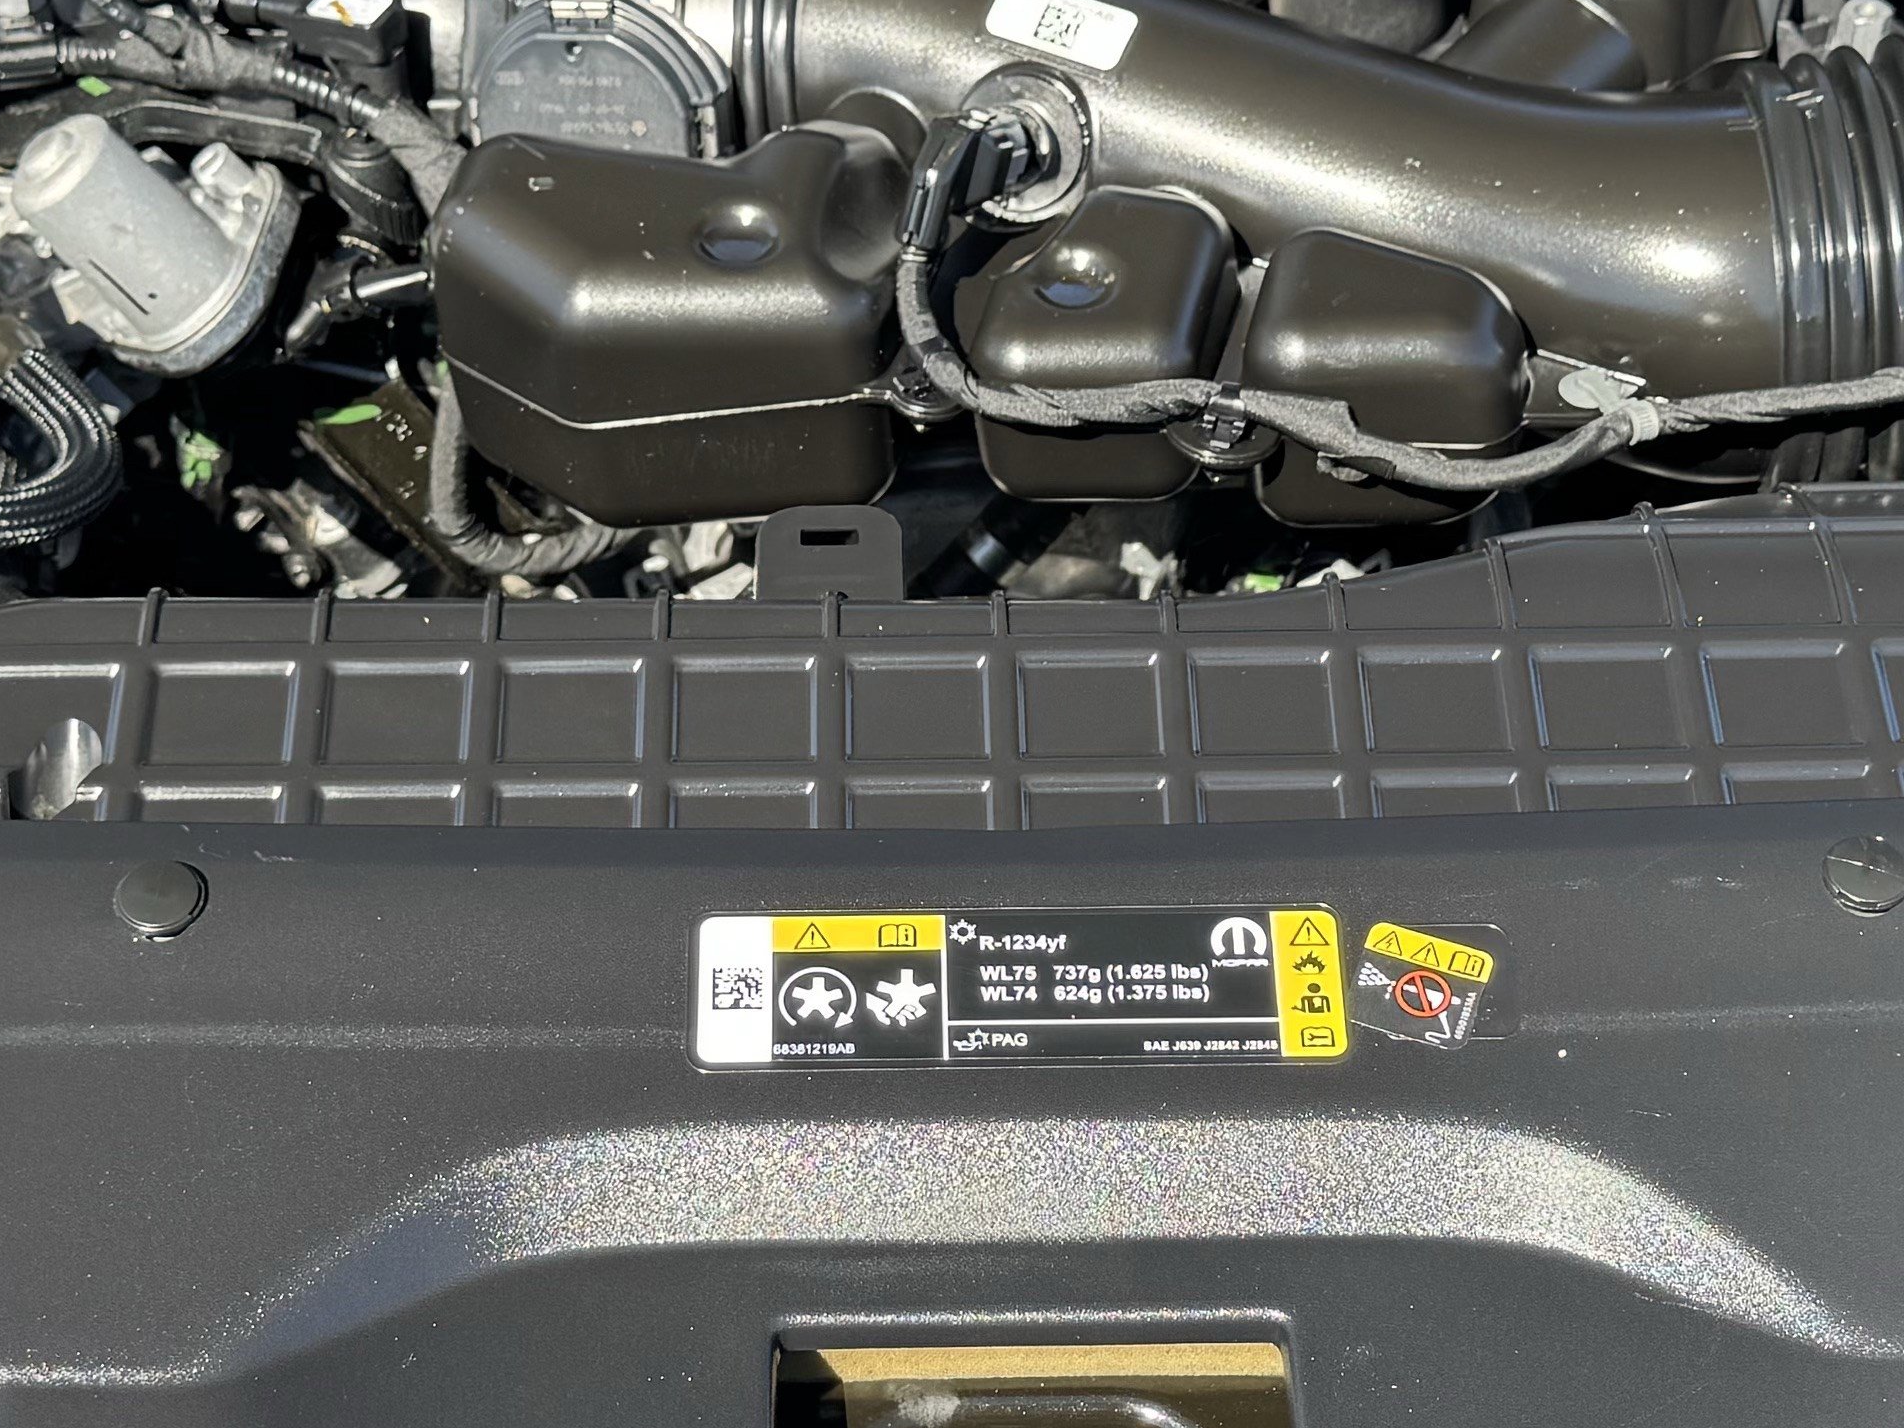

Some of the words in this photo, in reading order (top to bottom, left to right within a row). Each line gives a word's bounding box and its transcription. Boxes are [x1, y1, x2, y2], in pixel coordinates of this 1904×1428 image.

[979, 934, 1067, 954] R-1234yf
[979, 965, 1037, 982] WL75
[1053, 964, 1101, 984] 737g
[1106, 963, 1166, 983] (1.625
[1171, 962, 1209, 982] lbs)
[980, 985, 1038, 1002] WL74
[1053, 985, 1102, 1004] 624g
[1107, 984, 1167, 1004] (1.375
[1172, 984, 1210, 1003] lbs)
[991, 1032, 1028, 1047] PAG
[1143, 1040, 1170, 1051] SAE
